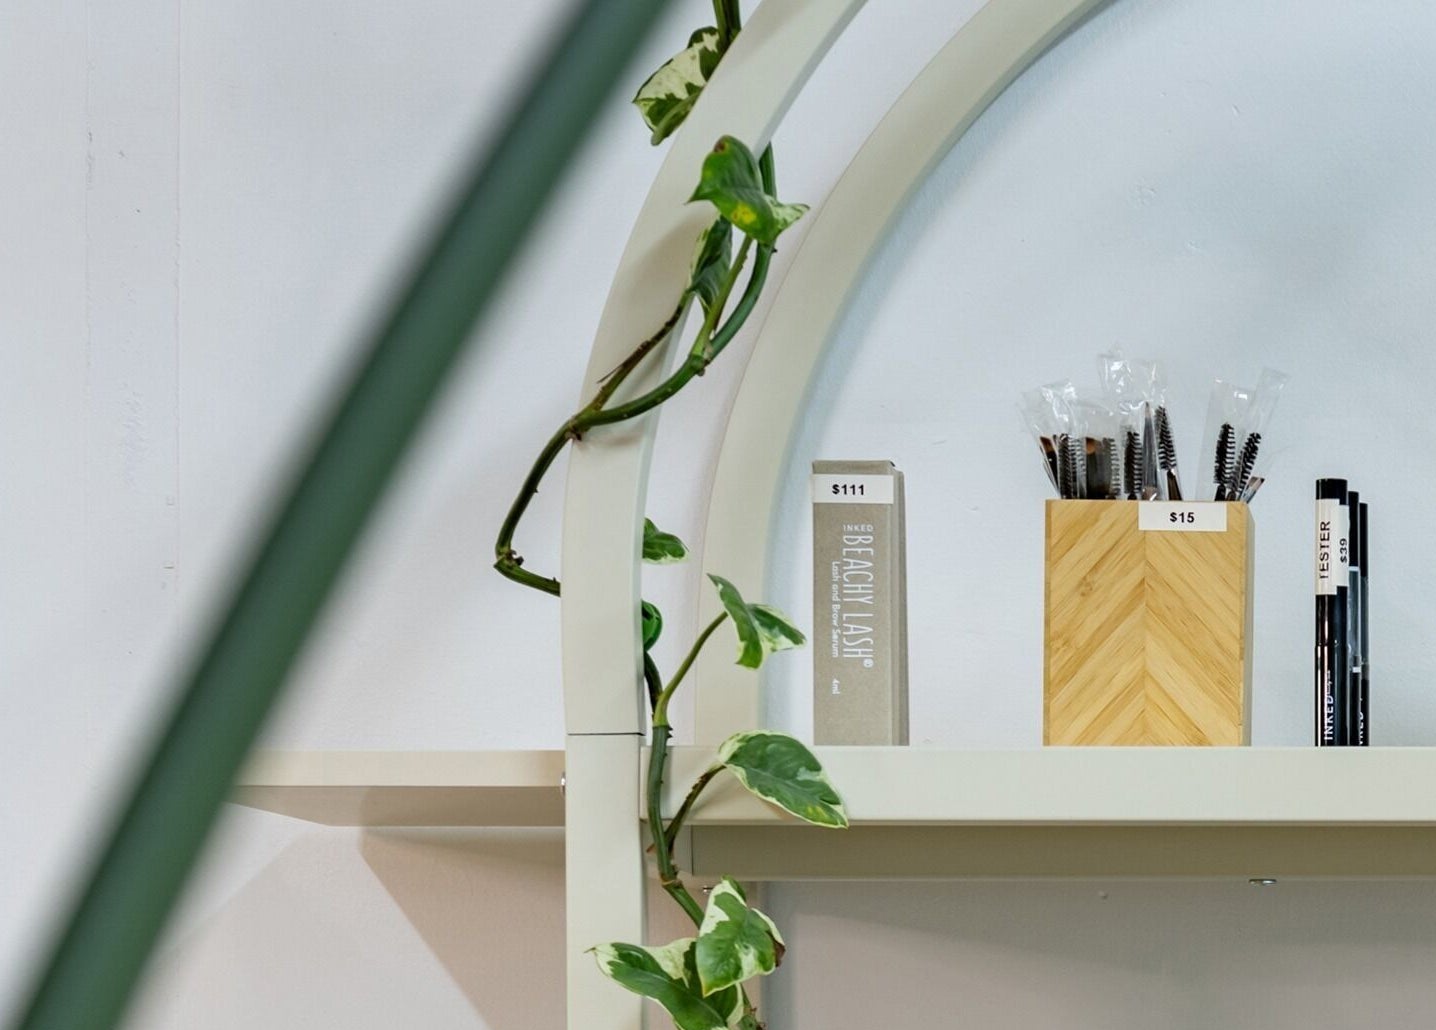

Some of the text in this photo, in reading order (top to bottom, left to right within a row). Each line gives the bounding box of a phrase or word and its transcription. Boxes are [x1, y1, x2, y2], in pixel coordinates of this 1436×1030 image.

[831, 484, 865, 495] $111
[843, 524, 874, 532] INKED
[1170, 512, 1195, 523] $15
[1319, 521, 1330, 579] TESTER
[1339, 538, 1347, 563] $39
[831, 561, 840, 582] Lash
[843, 535, 874, 605] BEACHY
[831, 583, 840, 601] and
[831, 604, 840, 627] Brow
[831, 630, 841, 658] Serum
[1324, 696, 1334, 740] INKED
